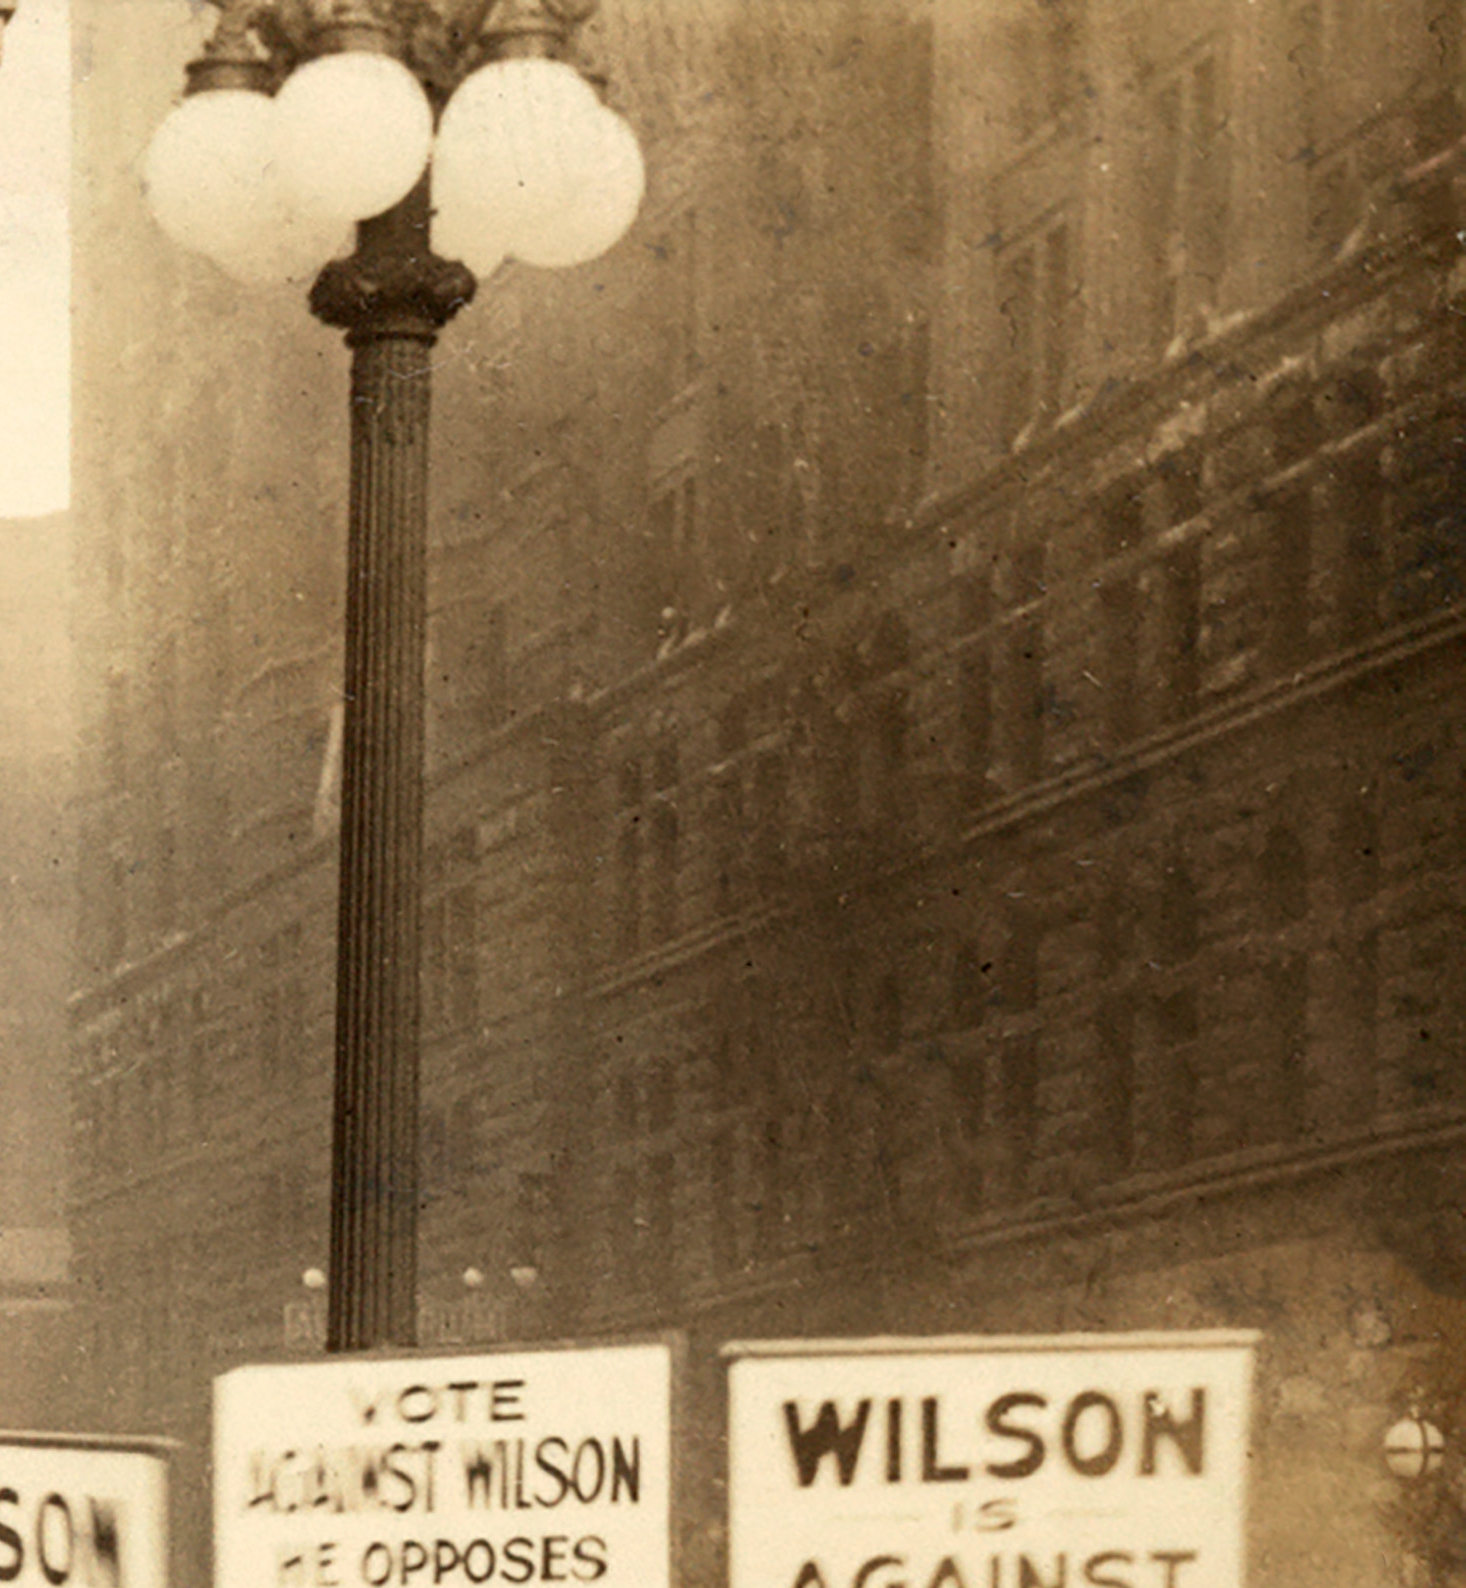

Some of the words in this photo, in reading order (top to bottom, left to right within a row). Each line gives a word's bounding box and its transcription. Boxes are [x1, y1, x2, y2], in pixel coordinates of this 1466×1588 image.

[347, 1379, 526, 1426] VOTE
[782, 1385, 1207, 1488] WILSON
[462, 1434, 641, 1510] WILSON
[950, 1497, 1020, 1533] IS
[360, 1535, 609, 1588] OPPOSES
